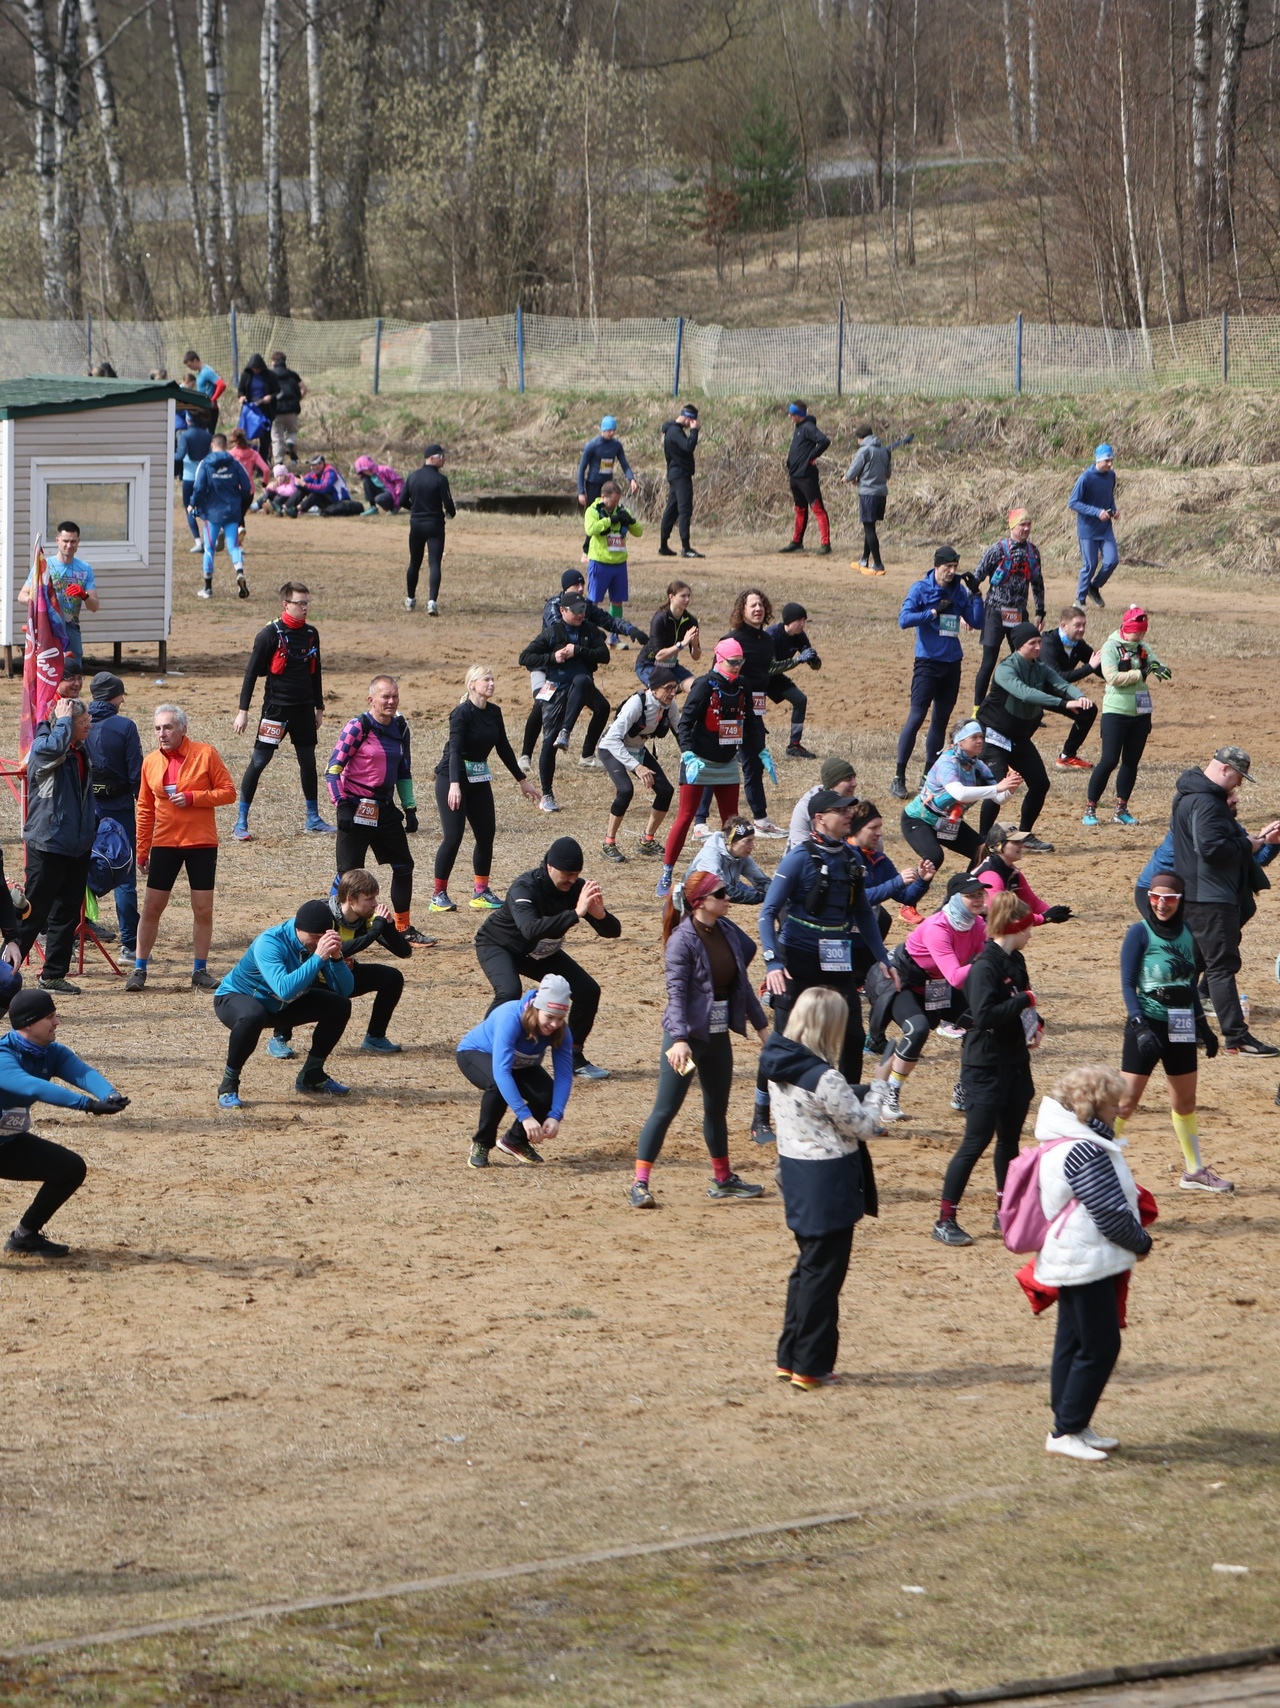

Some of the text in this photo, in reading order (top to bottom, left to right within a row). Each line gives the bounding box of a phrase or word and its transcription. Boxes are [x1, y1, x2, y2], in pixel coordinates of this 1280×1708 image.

[945, 620, 956, 628] 411
[266, 727, 280, 735] 750
[724, 727, 738, 735] 749
[361, 806, 375, 815] 790
[826, 948, 843, 958] 300
[1175, 1019, 1191, 1028] 216
[5, 1115, 25, 1127] 264
